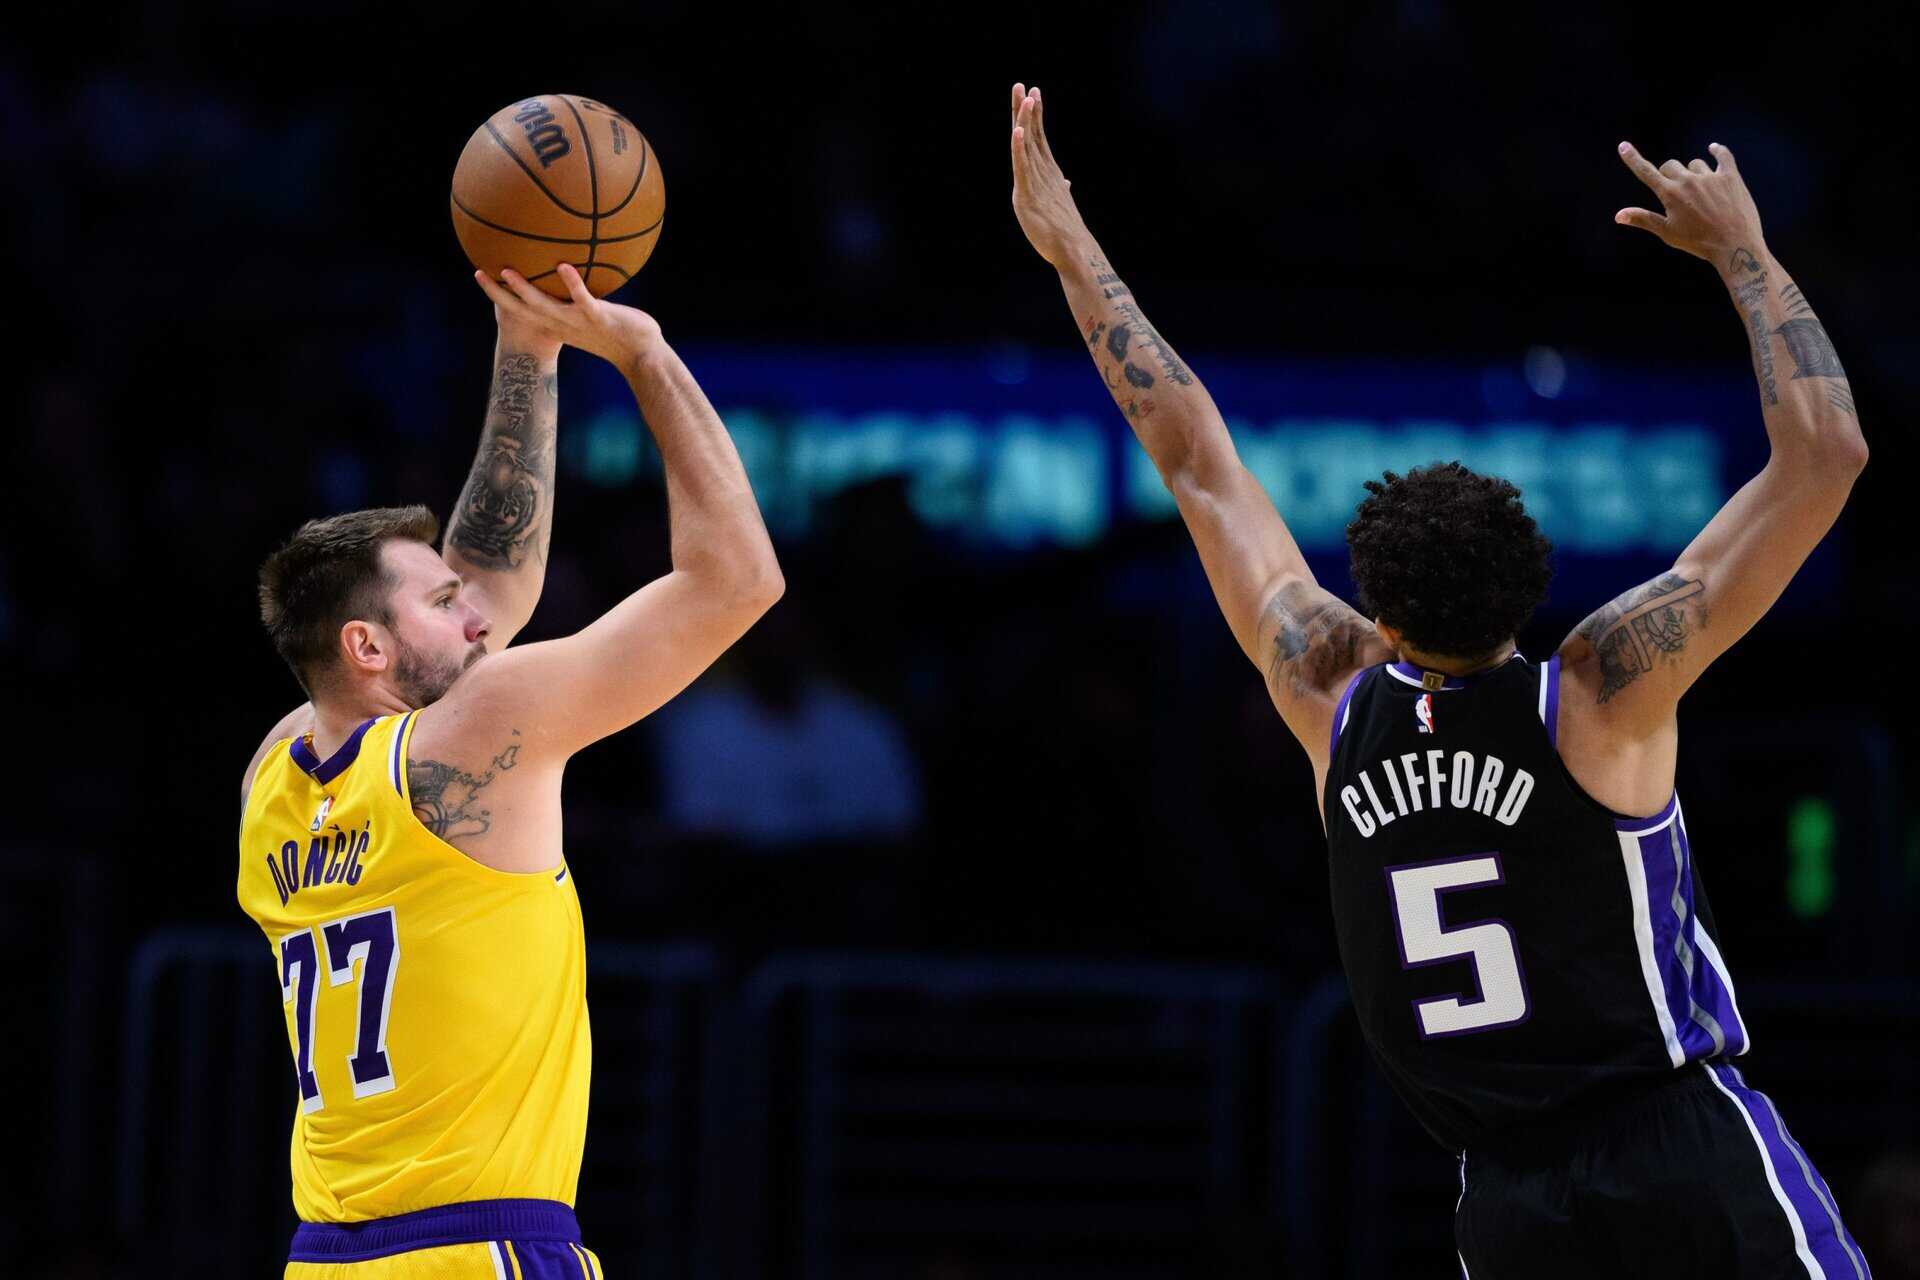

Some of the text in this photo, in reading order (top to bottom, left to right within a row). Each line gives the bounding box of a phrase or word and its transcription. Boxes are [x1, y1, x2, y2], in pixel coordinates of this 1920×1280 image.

[1341, 750, 1535, 838] CLIFFORD
[280, 905, 399, 1116] 77
[1385, 853, 1530, 1039] 5
